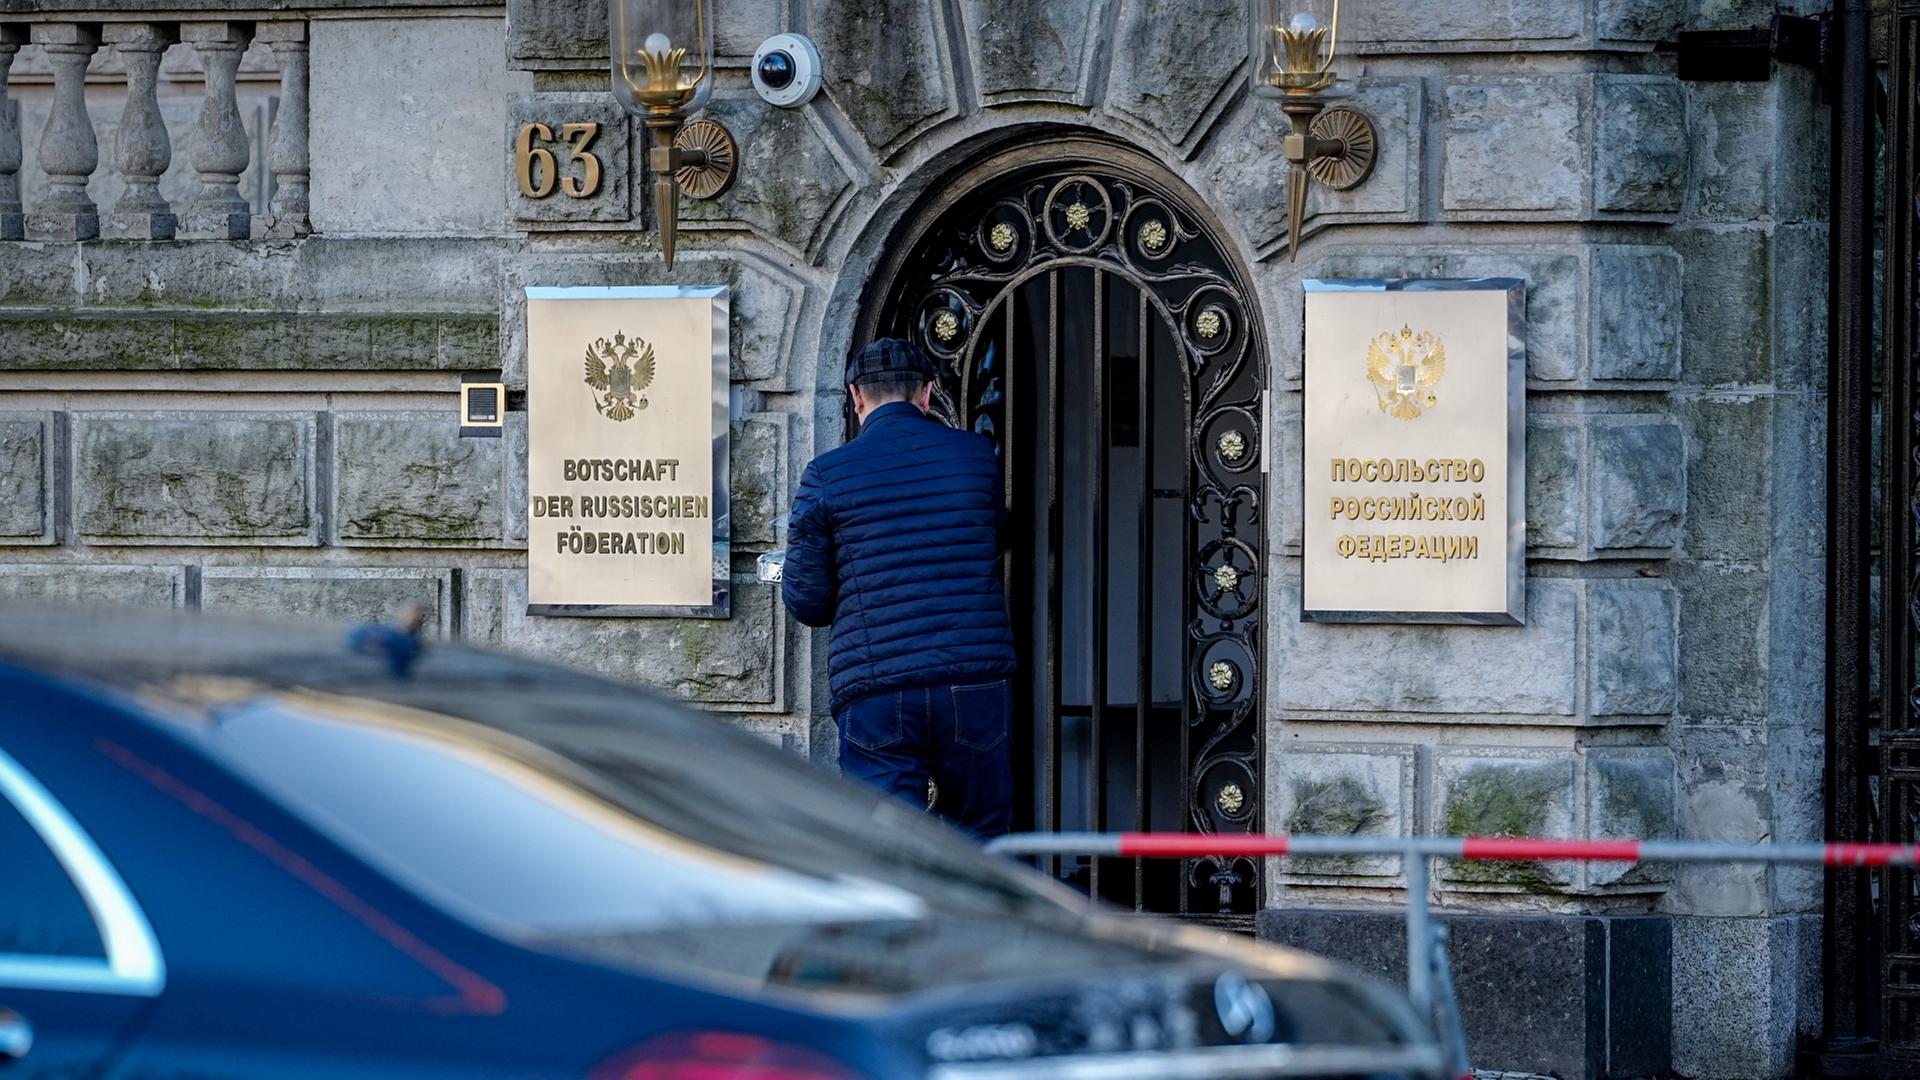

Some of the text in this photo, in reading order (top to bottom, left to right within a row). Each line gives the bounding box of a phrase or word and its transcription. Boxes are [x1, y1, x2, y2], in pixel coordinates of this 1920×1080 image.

[514, 122, 601, 198] 63
[563, 459, 679, 481] BOTSCHAFT
[1331, 459, 1485, 482] ПОСОЛЬСТВО
[532, 496, 708, 518] DER RUSSISCHEN
[1331, 493, 1485, 520] РОССИЙСКОЙ
[556, 525, 684, 554] FÖDERATION
[1337, 535, 1478, 562] ФЕДЕРАЦИИ
